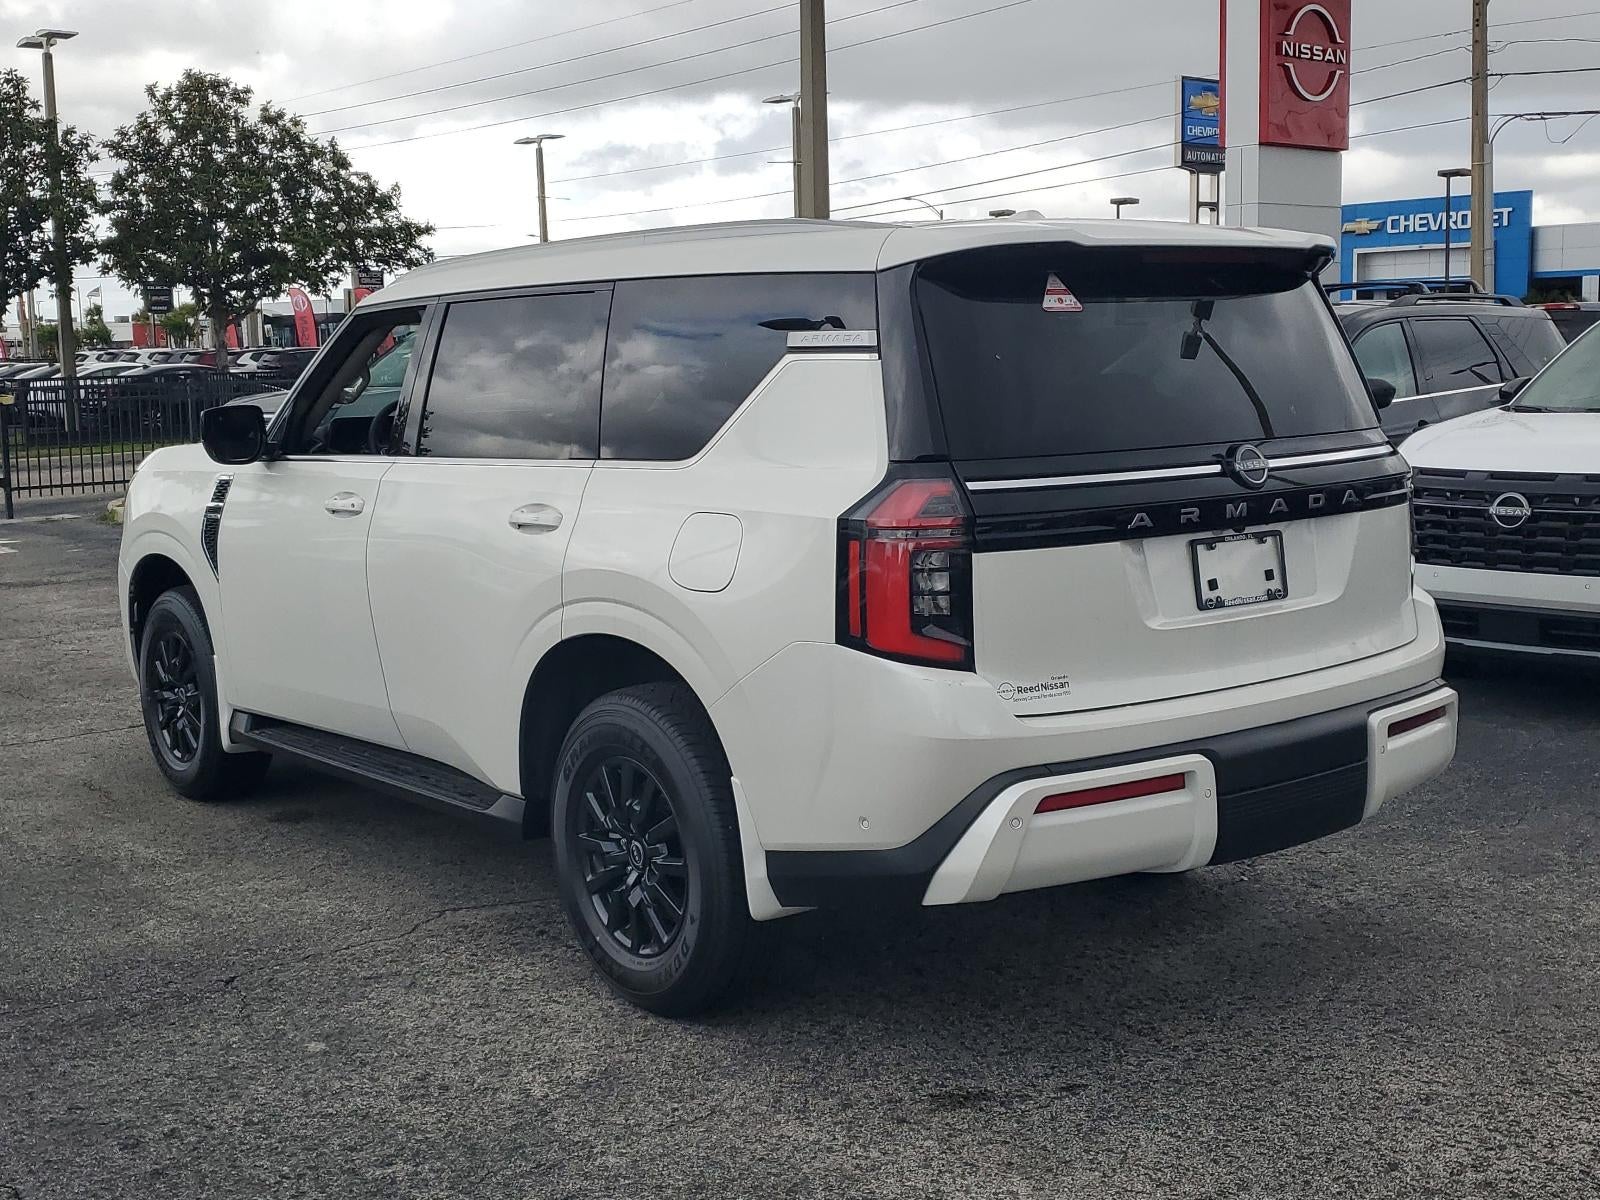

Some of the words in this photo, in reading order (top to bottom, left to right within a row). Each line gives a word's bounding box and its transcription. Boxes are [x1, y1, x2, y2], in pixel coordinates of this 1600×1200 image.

[1282, 40, 1346, 65] NISSAN
[1386, 207, 1513, 234] CHEVROET
[1234, 459, 1269, 472] NISSAN
[1128, 489, 1360, 529] ARMADA
[1489, 506, 1532, 517] NISSAN
